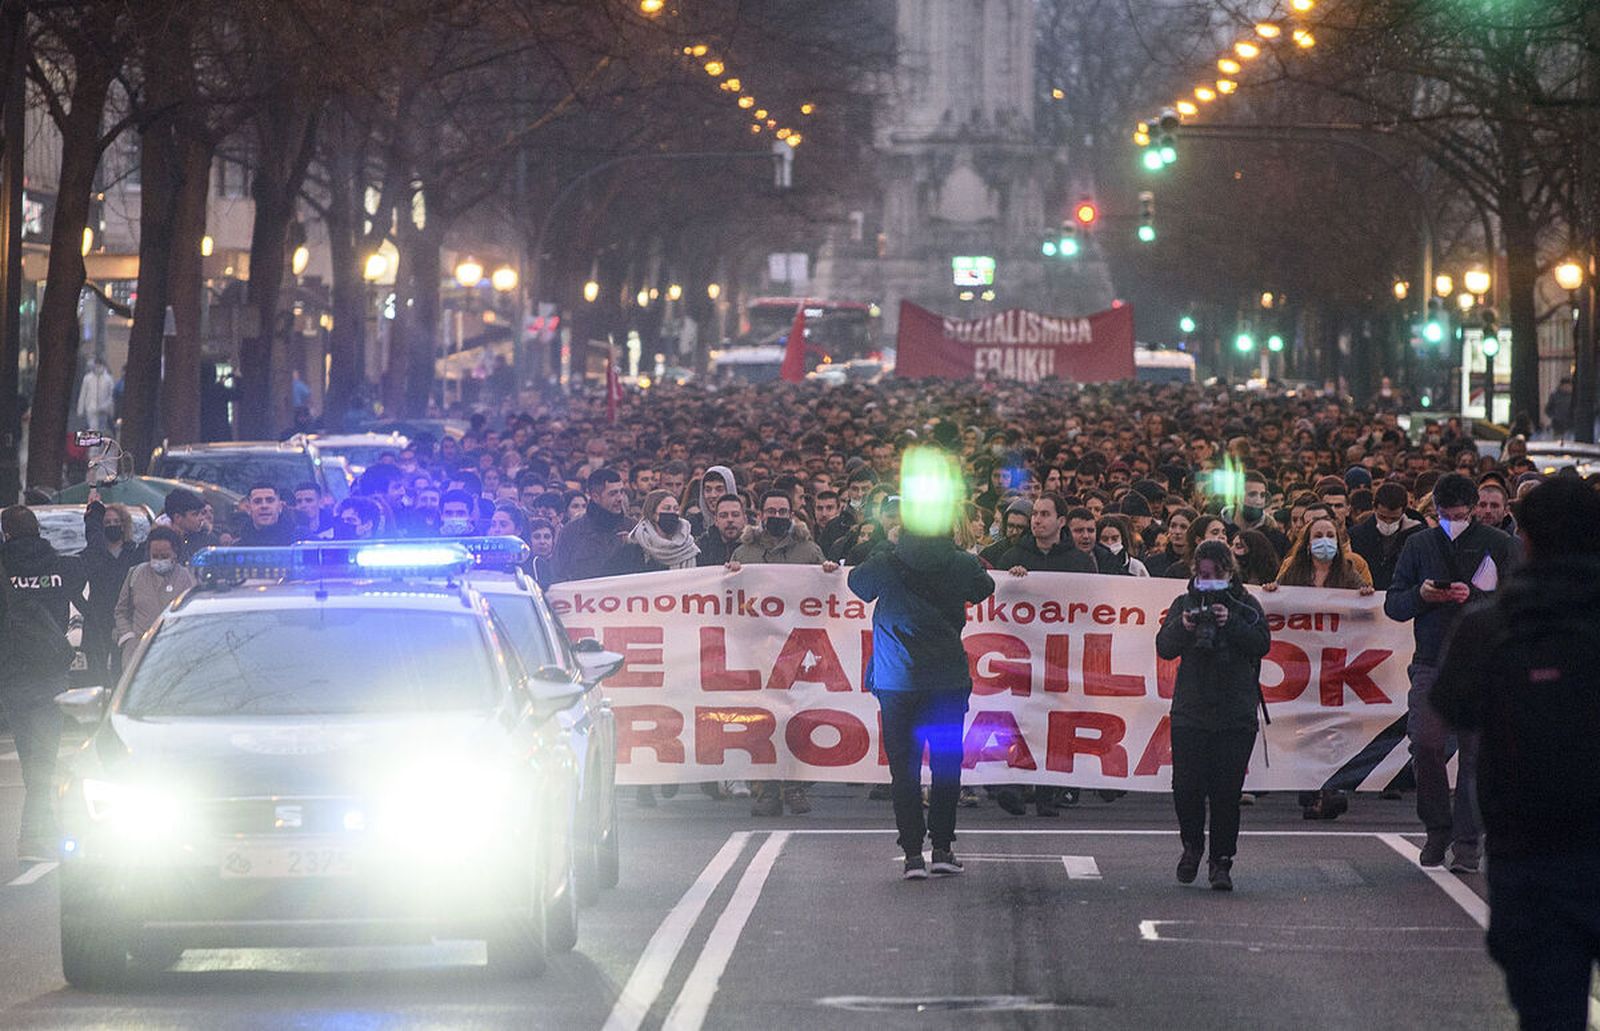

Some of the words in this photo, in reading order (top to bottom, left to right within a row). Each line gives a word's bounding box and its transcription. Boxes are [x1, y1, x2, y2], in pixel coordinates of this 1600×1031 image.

[551, 589, 785, 618] ekonomiko
[800, 593, 866, 619] eta
[964, 594, 1145, 625] tikoaren
[699, 626, 1393, 706] LAGILOK
